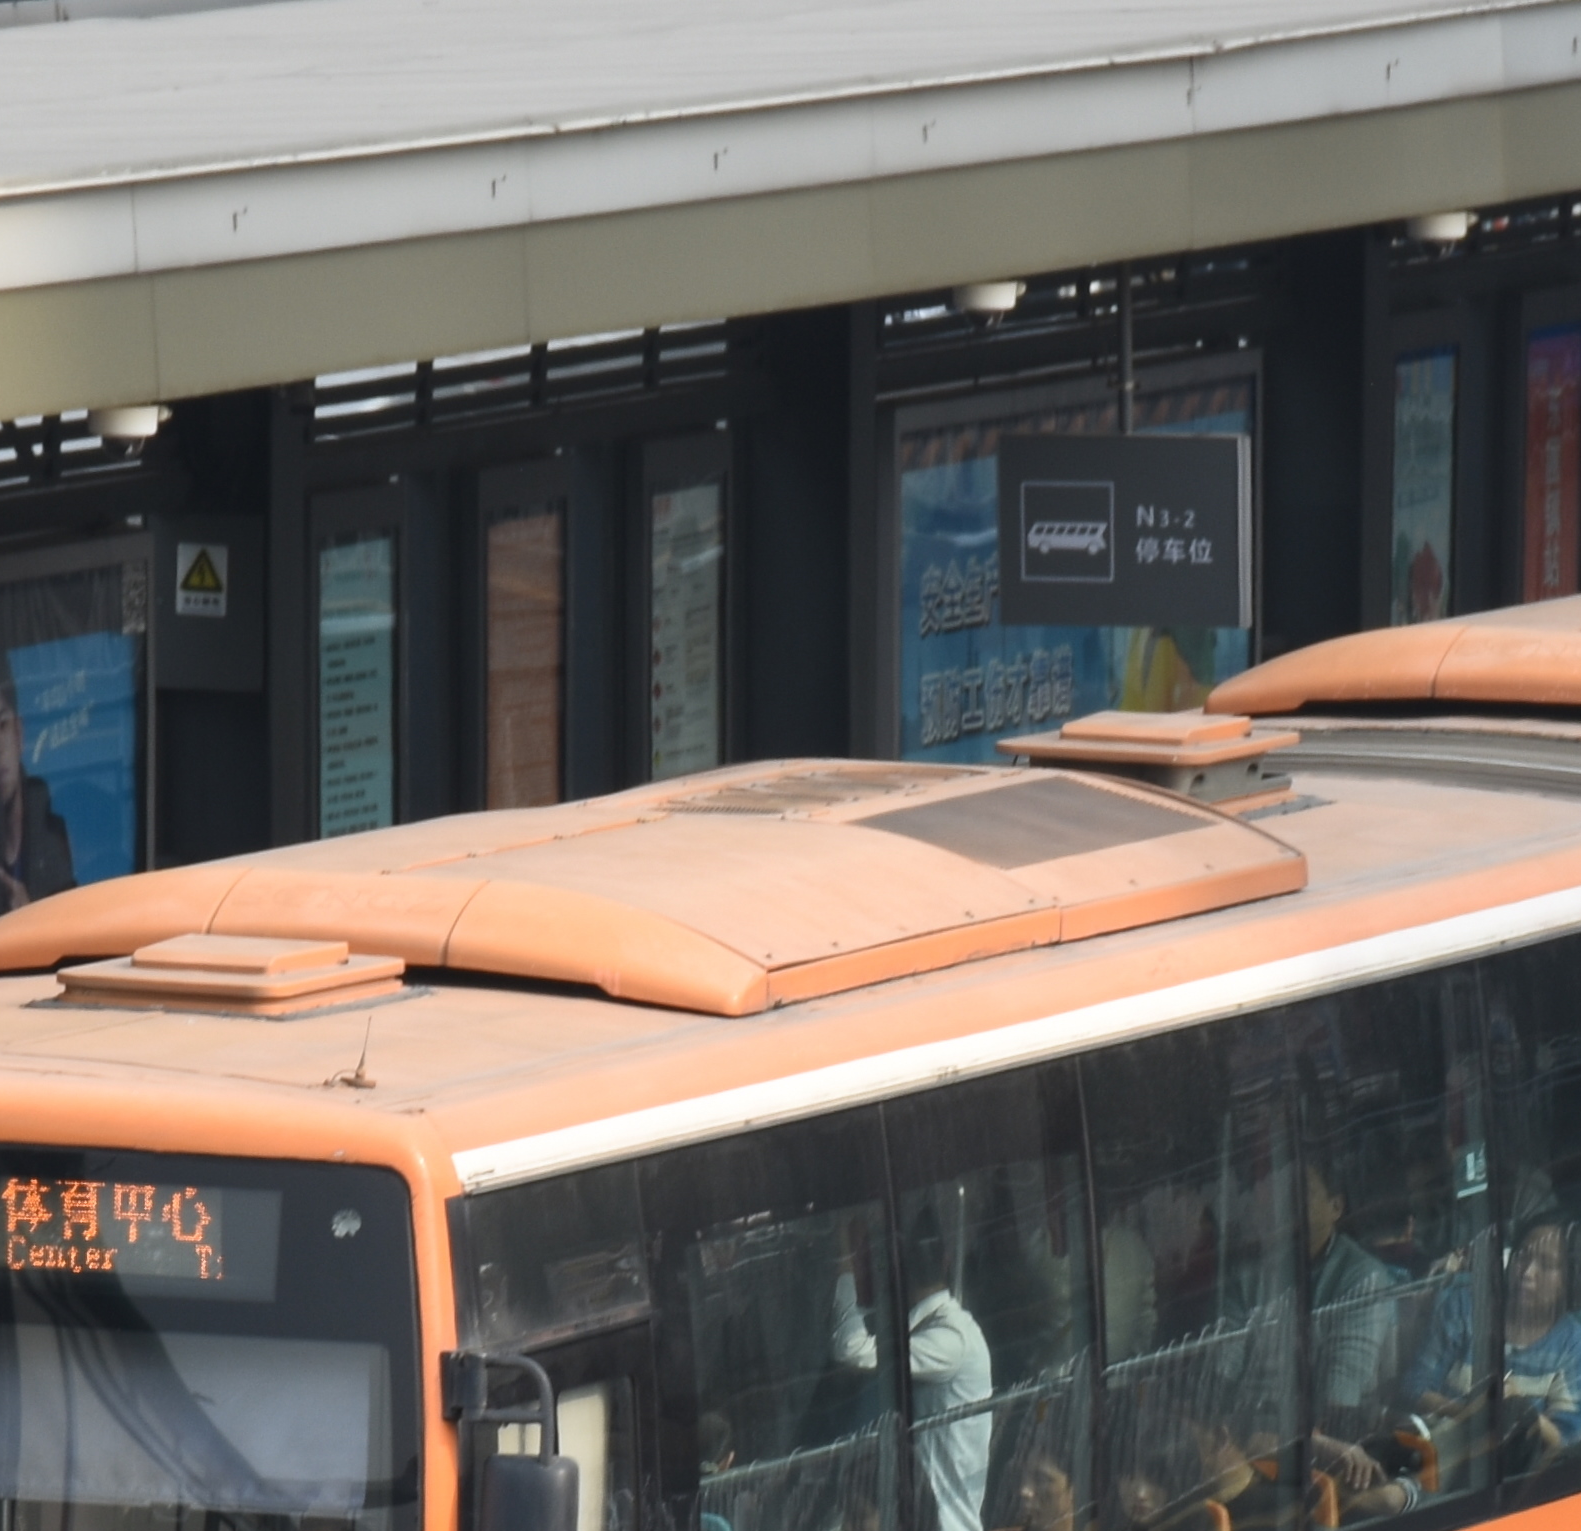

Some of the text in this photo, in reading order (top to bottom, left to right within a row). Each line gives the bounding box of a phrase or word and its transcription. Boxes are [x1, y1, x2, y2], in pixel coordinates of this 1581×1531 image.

[1135, 537, 1213, 564] 停车位
[1, 1178, 212, 1244] 体育中心
[7, 1235, 118, 1273] Center
